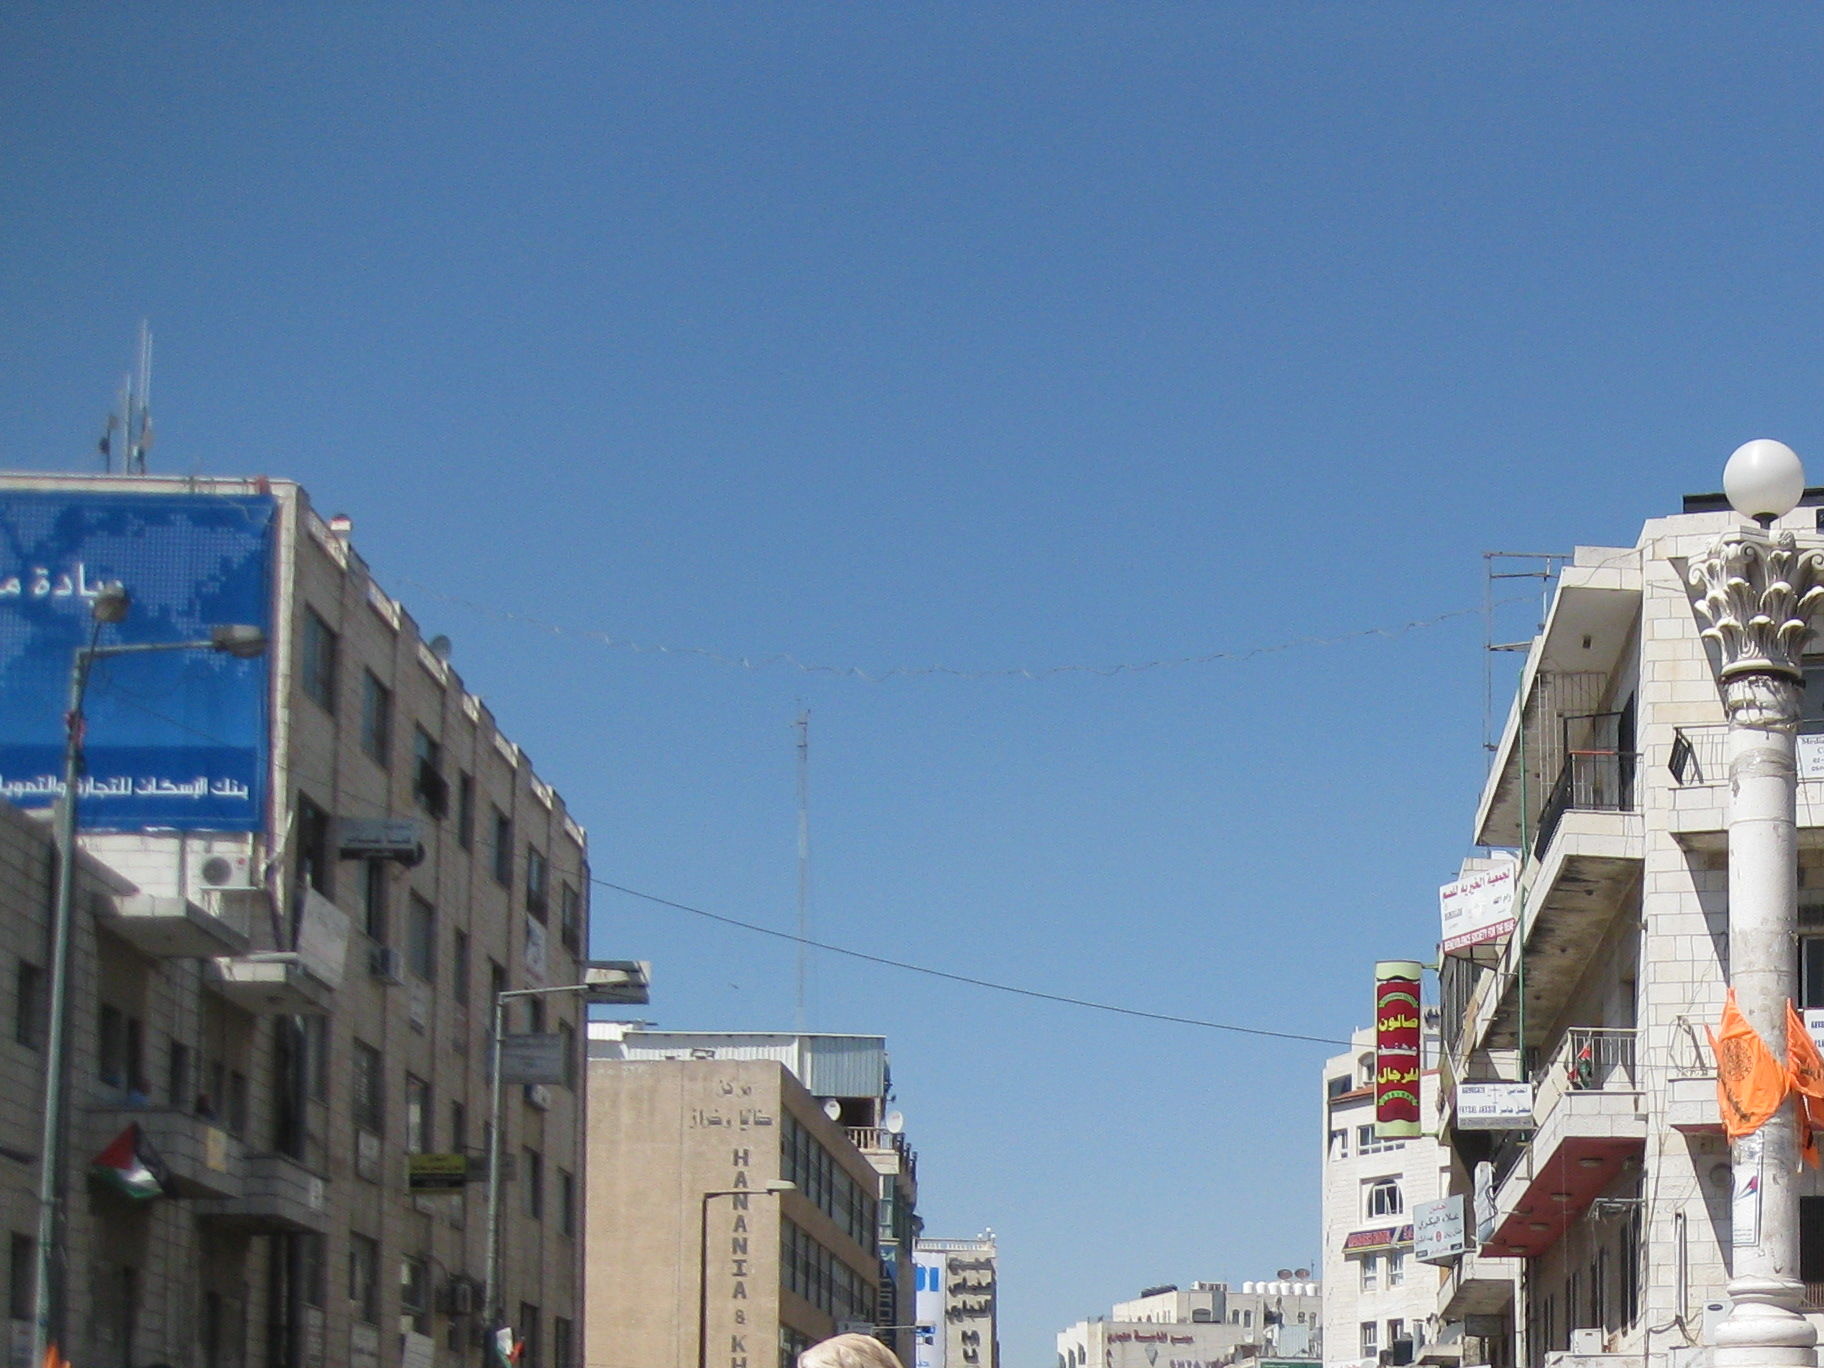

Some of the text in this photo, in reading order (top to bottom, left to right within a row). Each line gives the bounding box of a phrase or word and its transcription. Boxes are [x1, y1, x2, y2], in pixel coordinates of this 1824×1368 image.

[134, 776, 208, 800] الإسكان
[210, 776, 249, 800] بنك
[1377, 1013, 1419, 1033] صالون
[1377, 1066, 1419, 1086] للرجال
[731, 1149, 750, 1300] HANANIA
[734, 1309, 746, 1325] &
